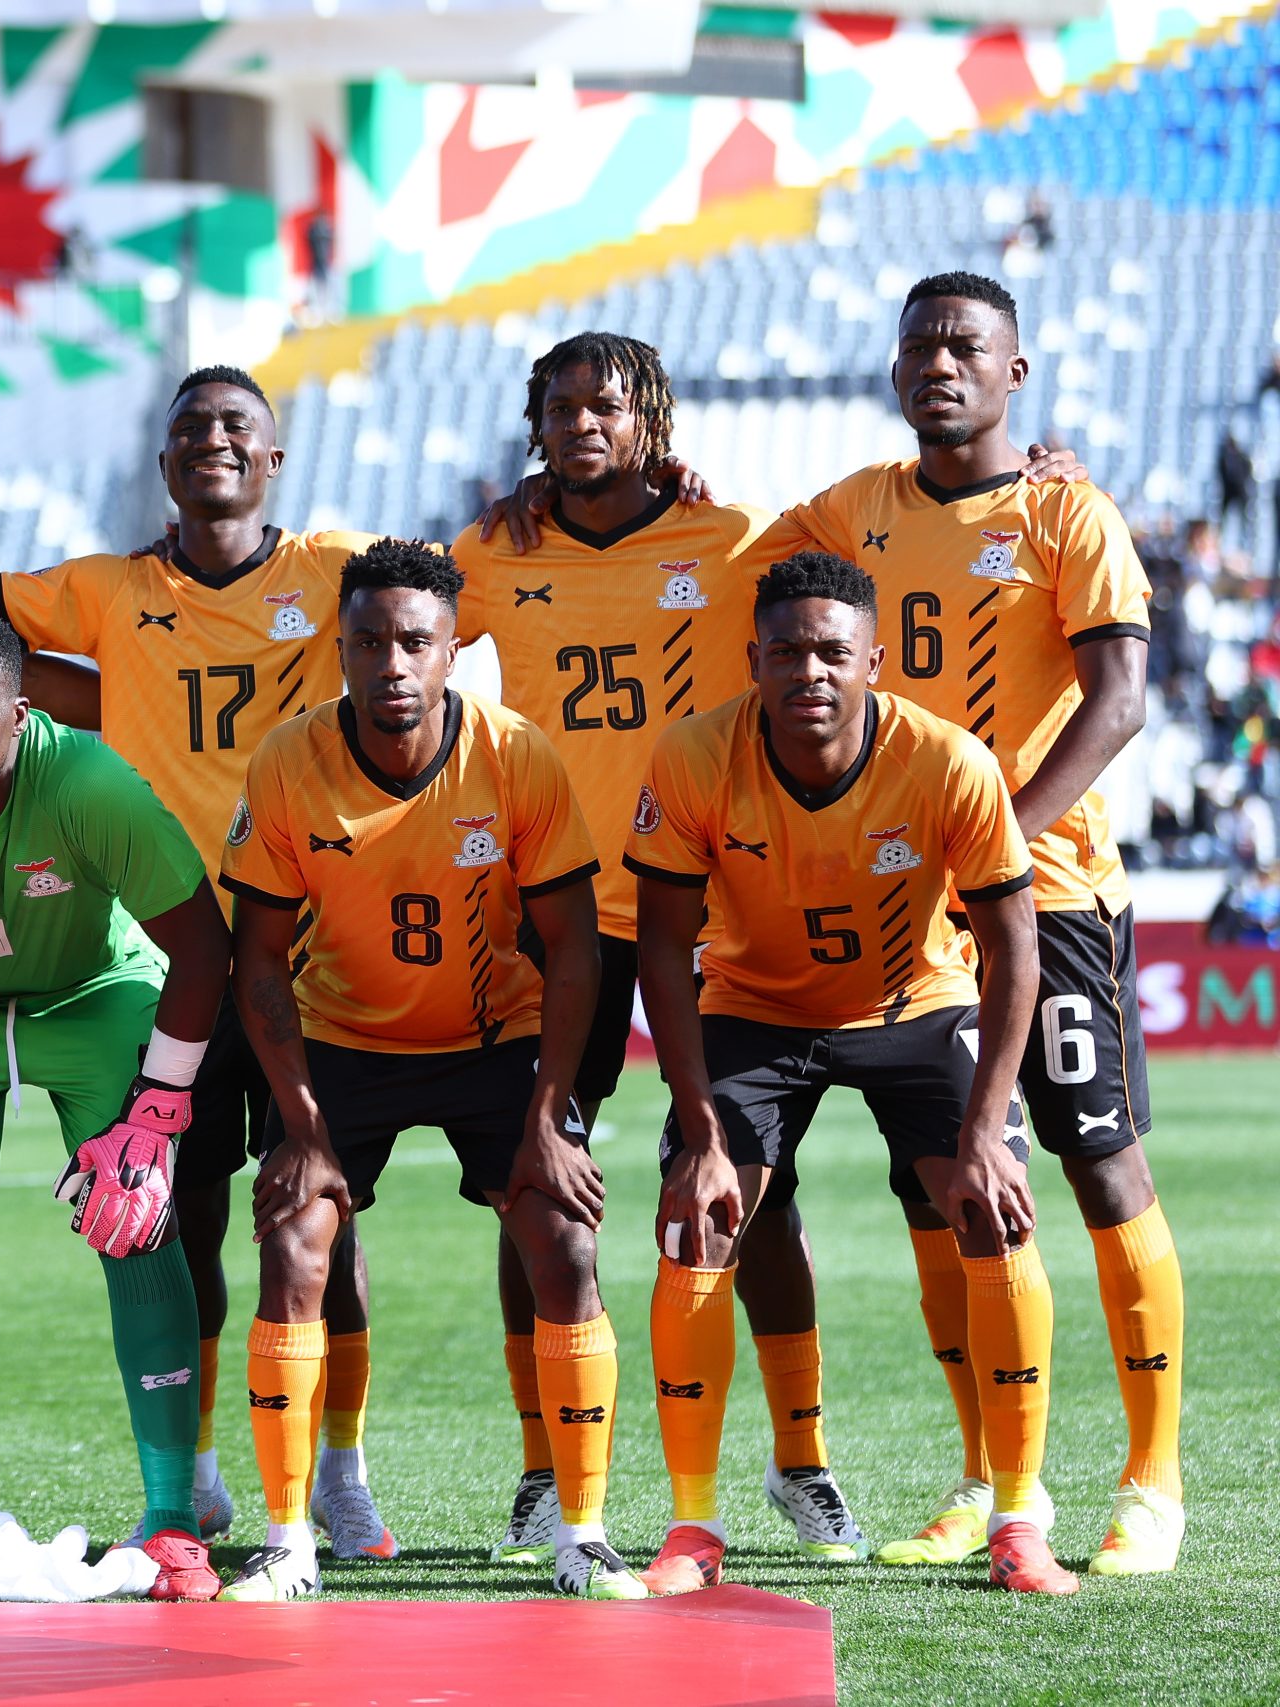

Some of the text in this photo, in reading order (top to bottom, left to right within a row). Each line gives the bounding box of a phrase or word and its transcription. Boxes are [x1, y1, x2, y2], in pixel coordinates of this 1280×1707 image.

[901, 591, 943, 679] 6
[177, 664, 256, 752] 17
[556, 643, 647, 731] 25
[884, 862, 910, 872] ZAMBIA
[391, 892, 442, 966] 8
[802, 904, 862, 964] 5
[1041, 994, 1097, 1084] 6
[73, 1182, 92, 1228] HO SOCCER
